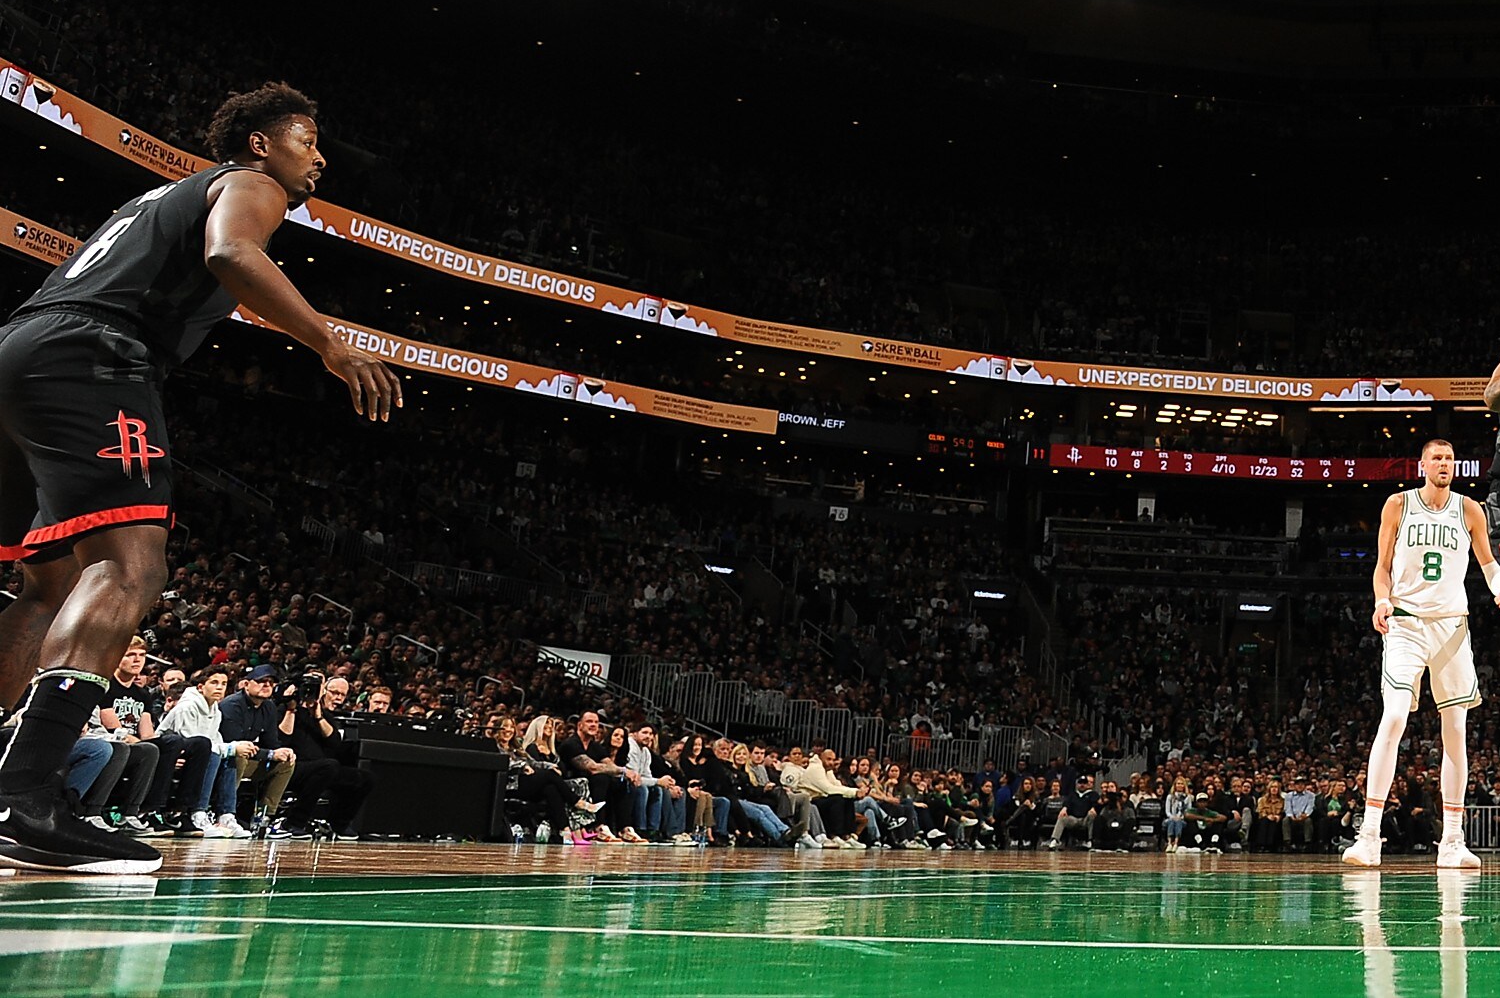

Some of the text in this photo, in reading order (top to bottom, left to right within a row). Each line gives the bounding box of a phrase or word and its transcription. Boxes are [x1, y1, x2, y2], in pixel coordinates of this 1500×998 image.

[129, 148, 168, 171] PEANUT BUTTER
[132, 134, 198, 174] SKREWBALL
[25, 241, 47, 255] PEANUT
[348, 217, 596, 303] UNEXPECTEDLY DELICIOUS
[403, 344, 508, 382] DELICIOUS
[874, 342, 942, 361] SKREWBALL
[1077, 368, 1313, 398] UNEXPECTEDLY DELICIOUS
[821, 418, 846, 430] JEFF
[1033, 448, 1045, 460] 11
[1105, 457, 1354, 478] 10 8 2 3 4/10 12/23 52 6 5
[1407, 523, 1459, 551] CELTICS
[1422, 551, 1443, 582] 8
